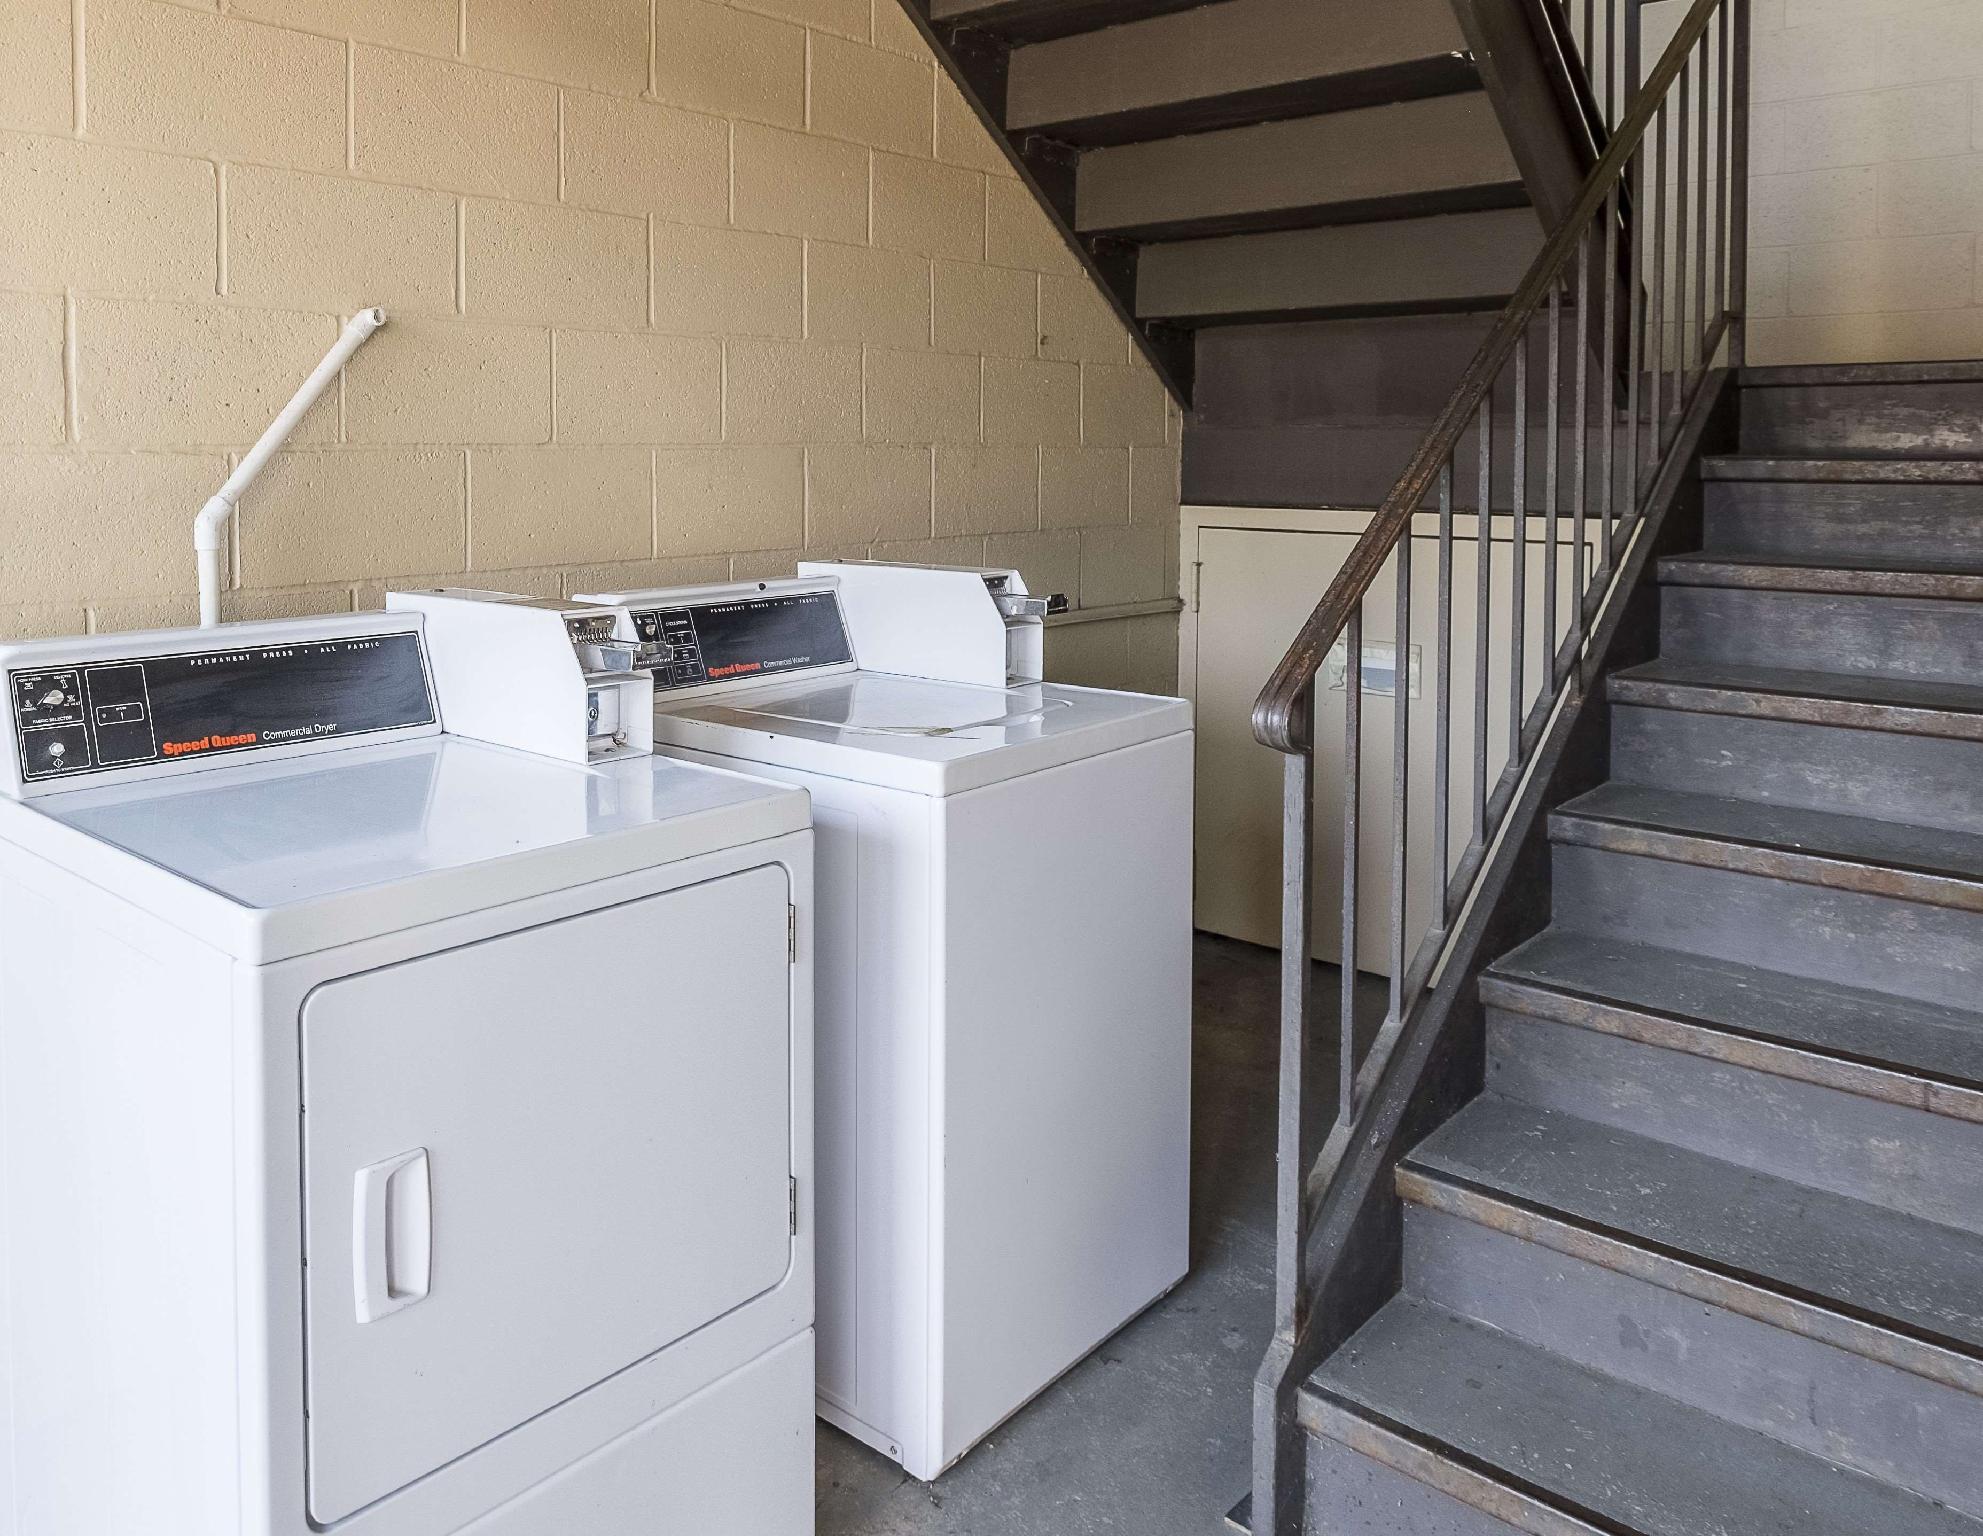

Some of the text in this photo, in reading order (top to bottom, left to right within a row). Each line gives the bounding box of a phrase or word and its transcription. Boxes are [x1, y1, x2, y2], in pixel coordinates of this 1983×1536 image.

[708, 664, 736, 678] Speed
[735, 662, 761, 673] Queen
[162, 722, 337, 756] Speed Queen Commercial Dryer
